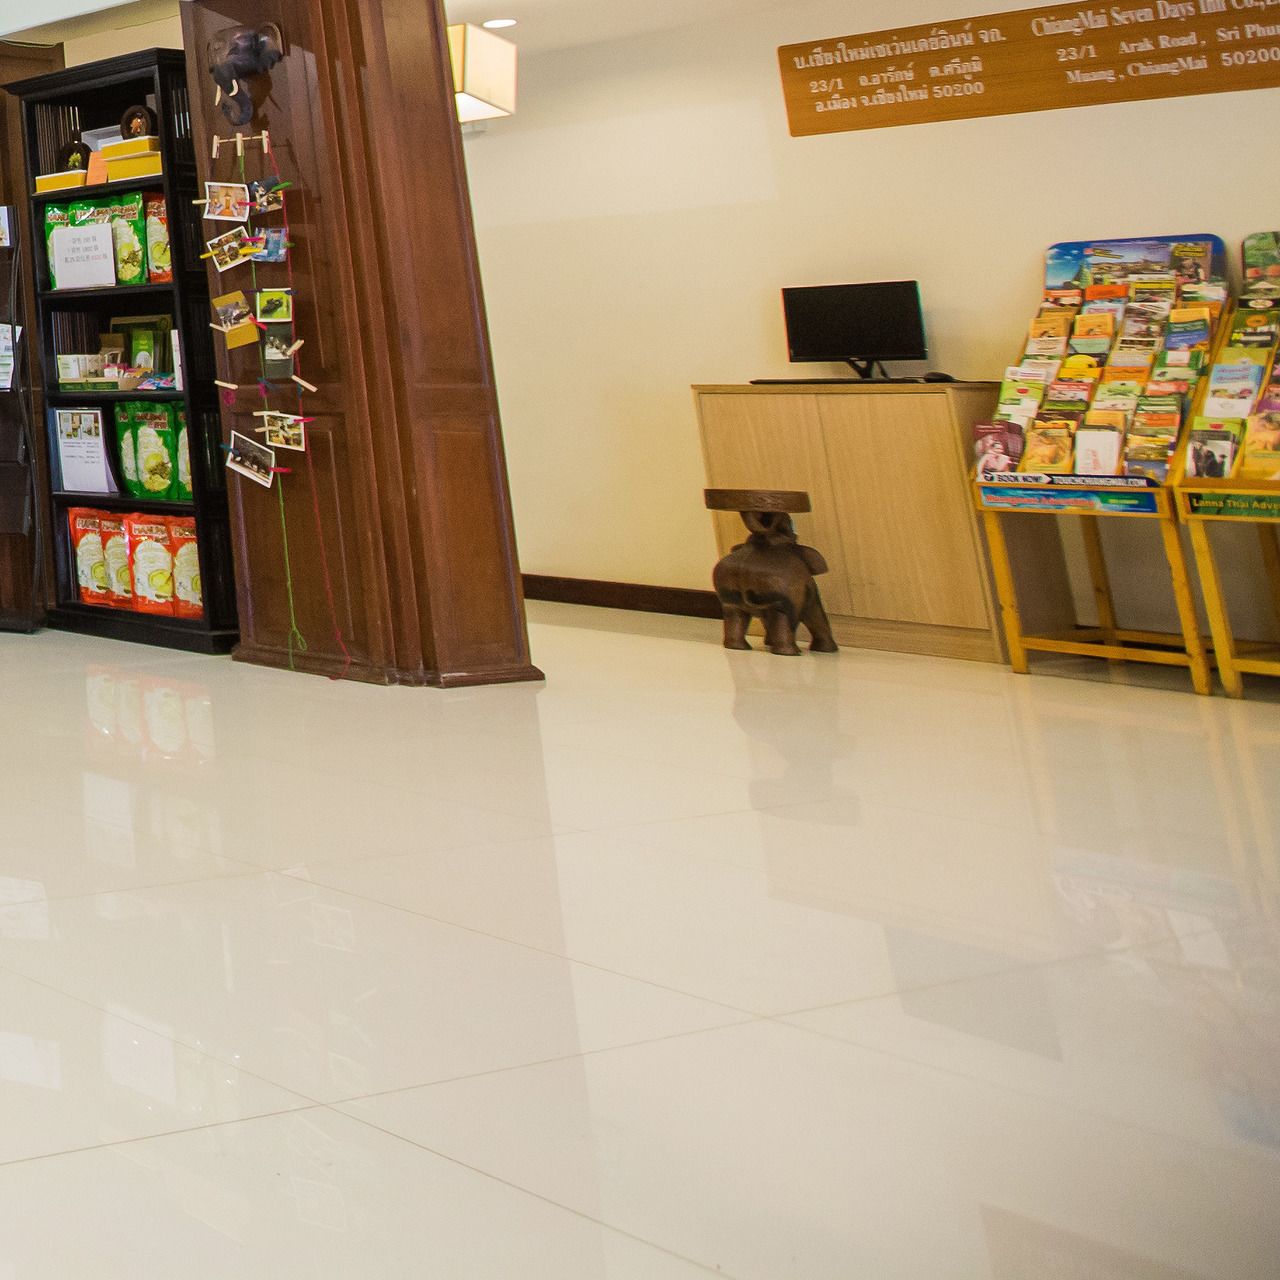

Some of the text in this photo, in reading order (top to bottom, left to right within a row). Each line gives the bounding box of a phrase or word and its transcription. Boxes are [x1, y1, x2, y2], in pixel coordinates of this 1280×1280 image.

[1031, 8, 1108, 36] ChiangMai
[1109, 6, 1156, 26] Seven
[1156, 0, 1196, 21] Days
[1056, 45, 1099, 61] 23/1
[1119, 37, 1156, 54] Arak
[1215, 26, 1241, 42] Sri
[1126, 55, 1208, 77] ChiangMai
[1220, 47, 1280, 67] 50200
[809, 78, 845, 94] 23/1
[932, 81, 985, 99] 50200
[1192, 498, 1224, 507] Lanna
[1227, 500, 1249, 508] Thai
